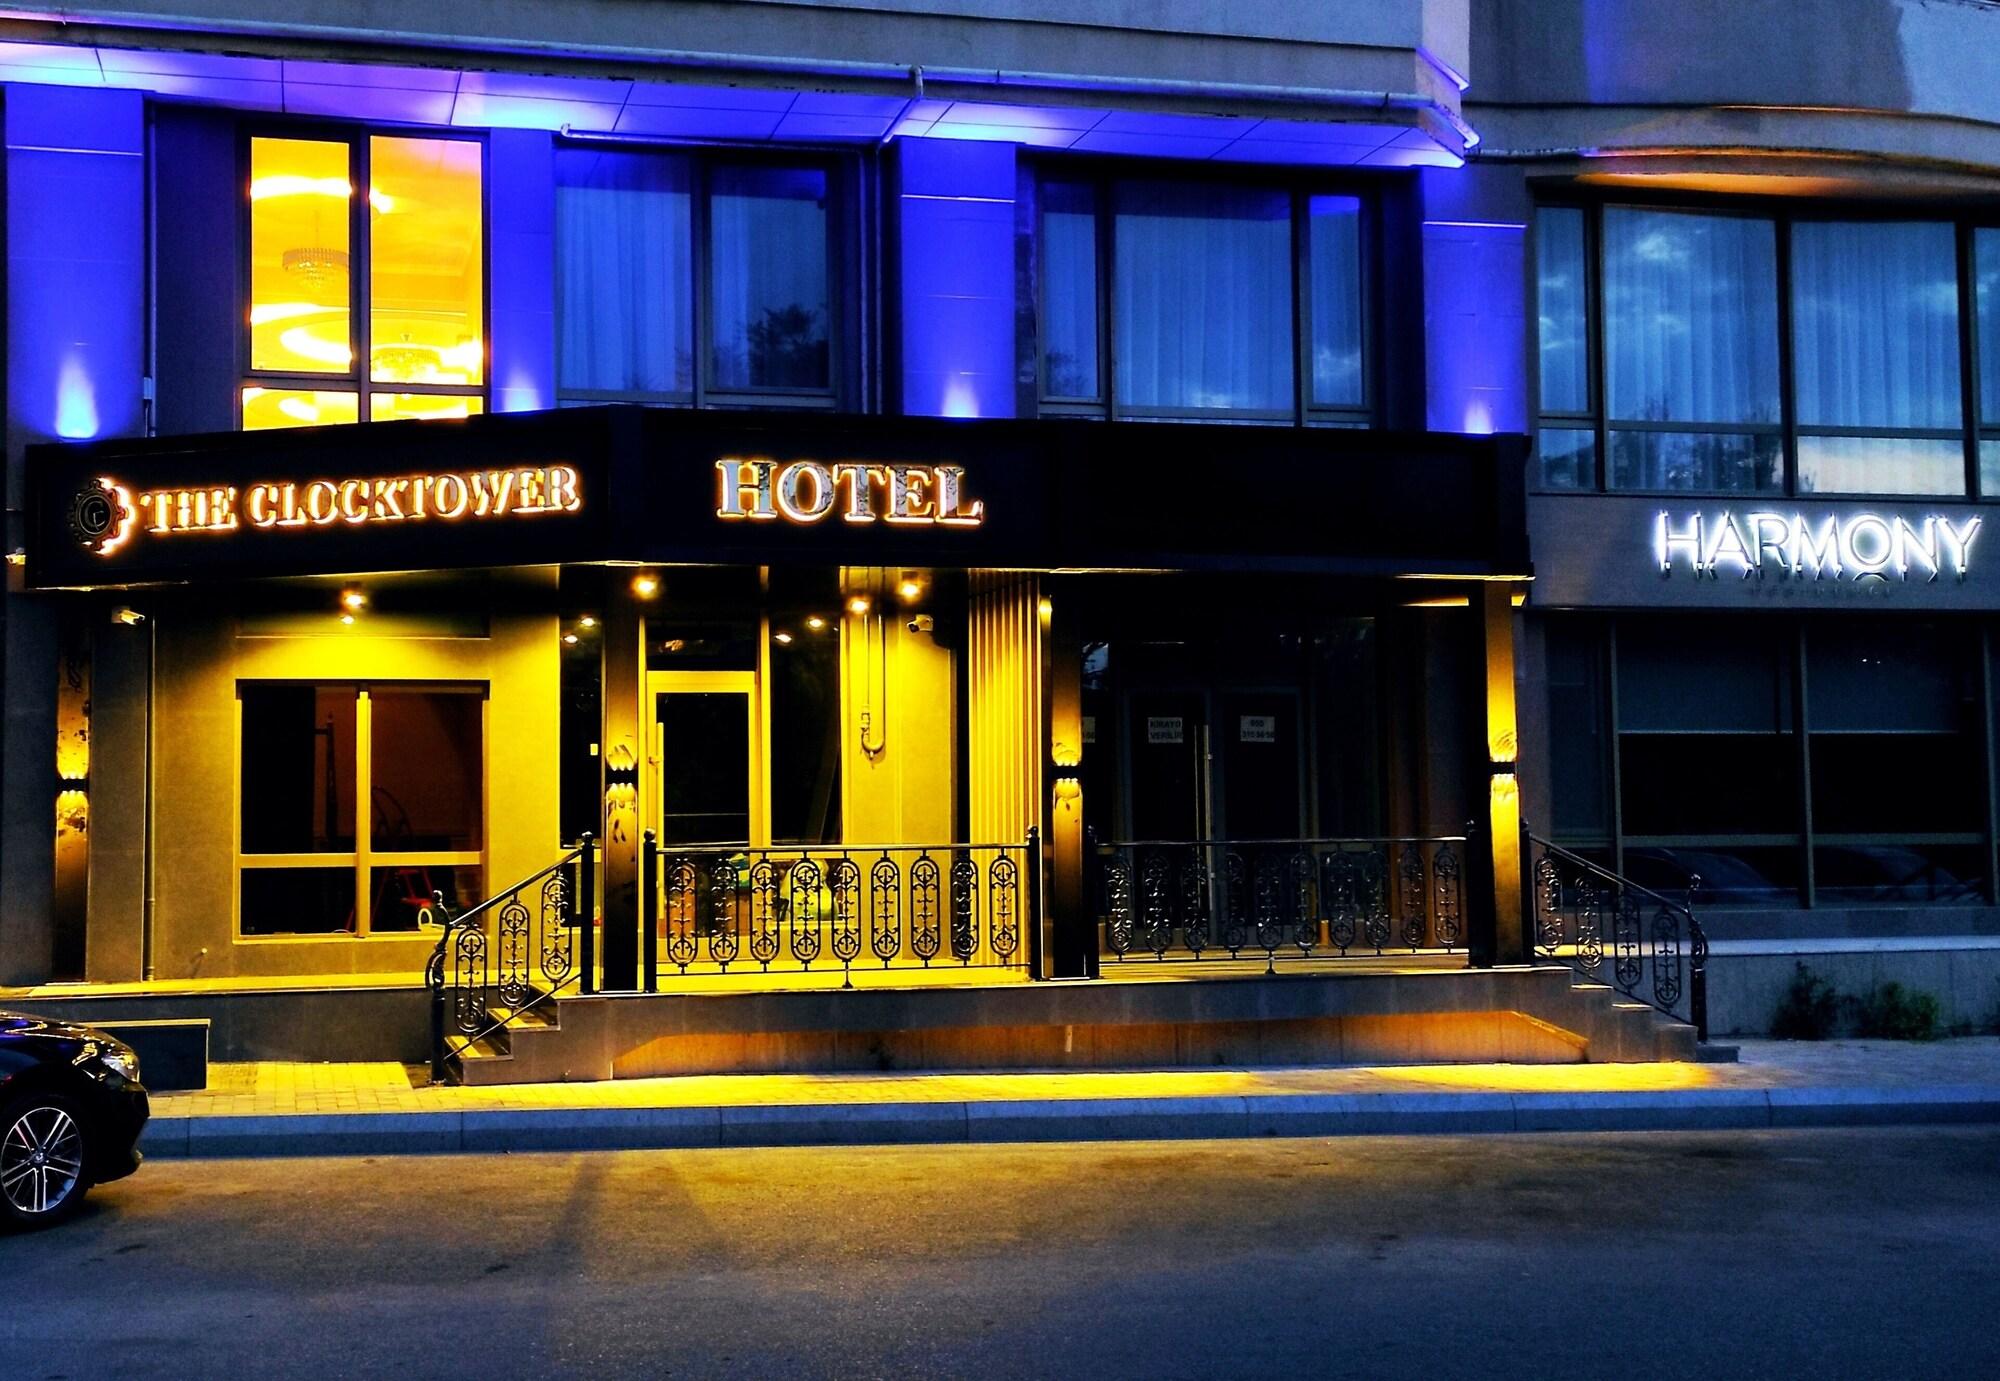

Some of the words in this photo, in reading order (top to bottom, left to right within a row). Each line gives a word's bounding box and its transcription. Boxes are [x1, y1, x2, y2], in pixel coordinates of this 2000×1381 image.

[140, 489, 236, 532] THE
[249, 466, 580, 527] CLOCKTOWER
[716, 460, 984, 524] HOTEL
[1654, 511, 1982, 575] HARMONY
